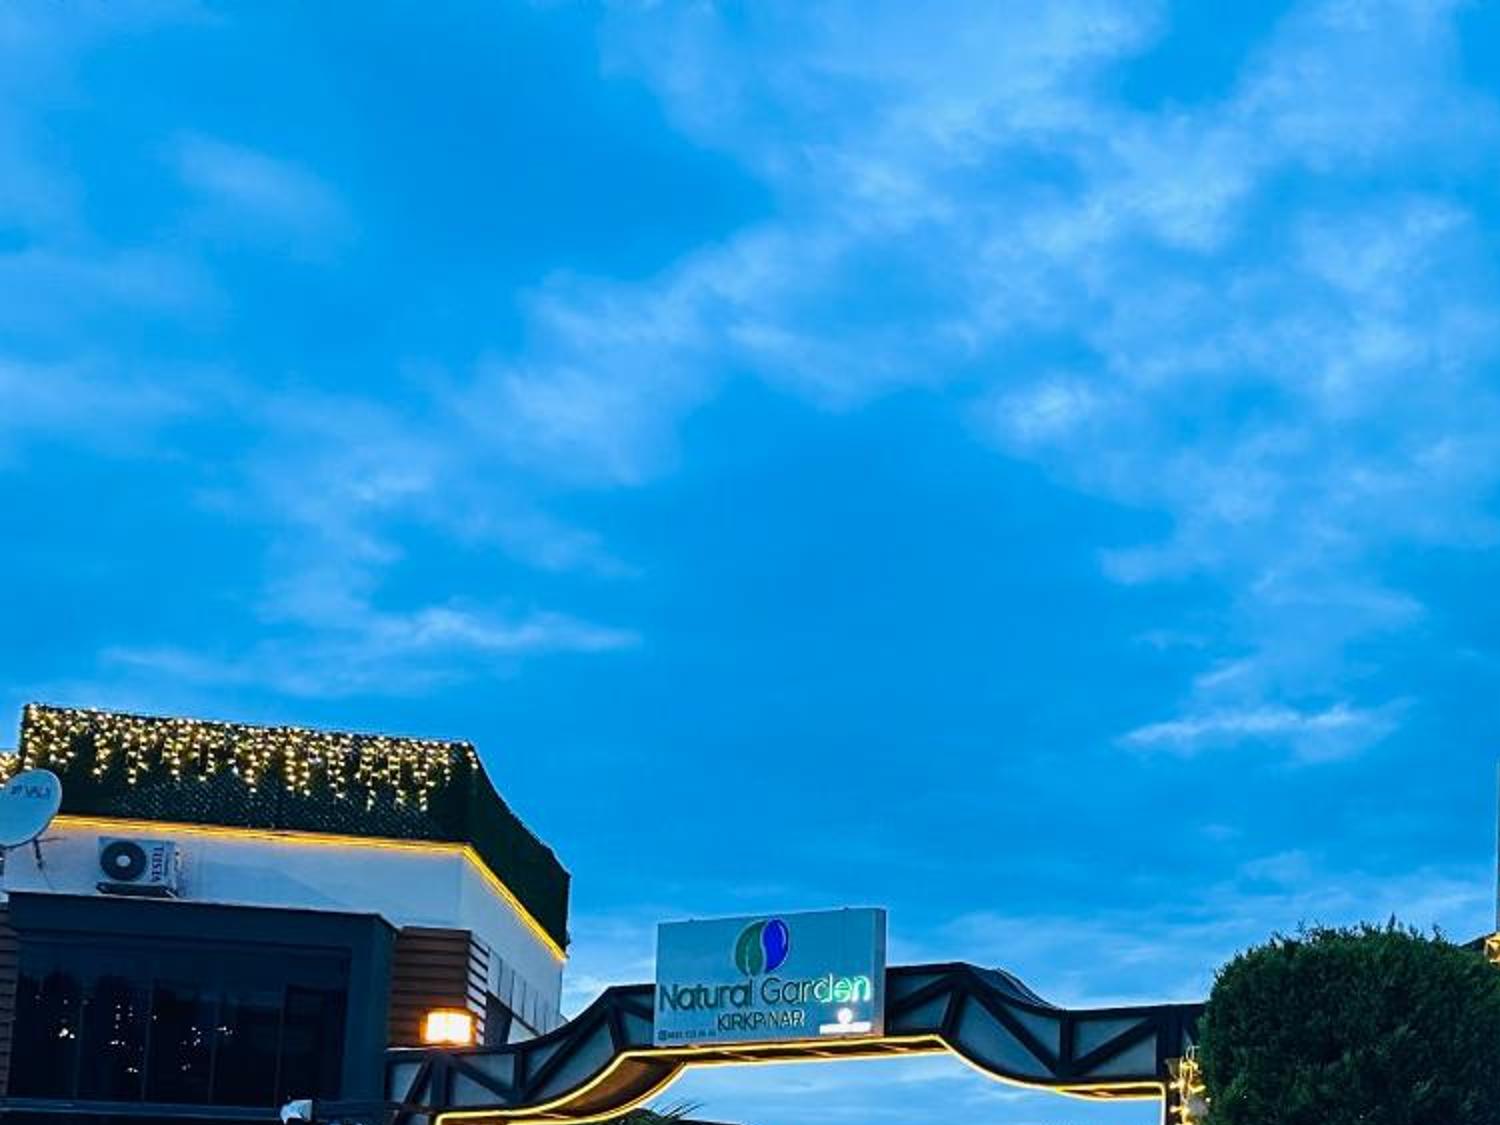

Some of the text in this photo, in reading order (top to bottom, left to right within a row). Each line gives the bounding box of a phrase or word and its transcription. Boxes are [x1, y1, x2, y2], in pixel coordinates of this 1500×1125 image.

[658, 972, 872, 1011] Natural Garden
[717, 1009, 805, 1032] KIRKPINAR
